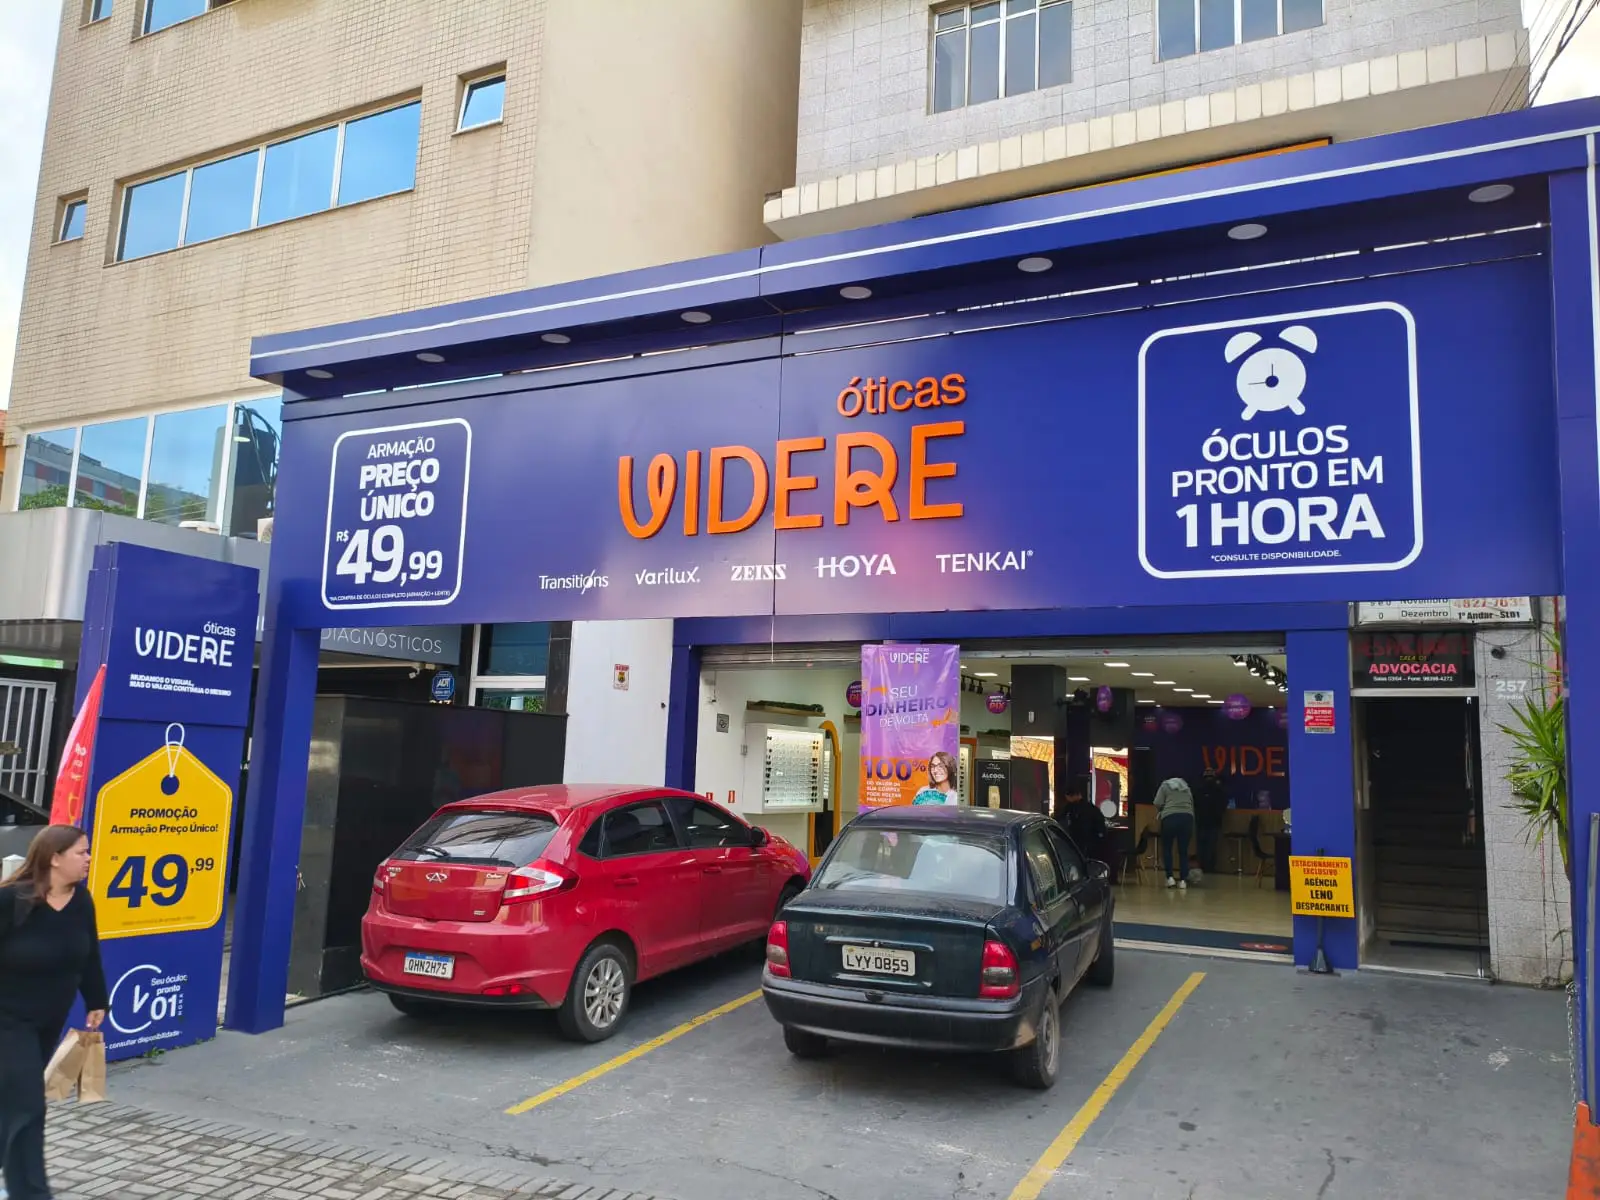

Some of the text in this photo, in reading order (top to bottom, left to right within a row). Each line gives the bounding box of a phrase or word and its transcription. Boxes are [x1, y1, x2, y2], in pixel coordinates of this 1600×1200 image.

[837, 373, 966, 417] óticas
[367, 436, 435, 458] ARMAÇÃO
[1202, 425, 1349, 463] ÓCULOS
[359, 458, 440, 491] PREÇO
[618, 420, 966, 539] VIDERE
[1172, 455, 1384, 497] PRONTO EM
[360, 489, 435, 521] ÚNICO
[1176, 493, 1386, 547] 1 HORA
[336, 530, 349, 542] R$
[1261, 550, 1342, 561] DISPONIBILIDADE.
[539, 569, 609, 595] Transitions
[731, 564, 787, 582] ZEISS
[815, 553, 896, 578] HOYA
[1401, 609, 1449, 617] Dezembro
[1467, 611, 1493, 619] Andar
[203, 621, 236, 636] óticas
[135, 627, 235, 667] VIDERE
[889, 652, 929, 664] VIDERE
[1369, 663, 1457, 674] ADVOCACIA
[130, 673, 164, 684] MUDAMOS
[891, 685, 918, 699] SEU
[1495, 680, 1526, 692] 257
[866, 697, 948, 716] DINHEIRO
[880, 713, 929, 728] DE VOLTA
[129, 806, 198, 820] PROMOÇÃO
[110, 821, 218, 836] Armação Preço Único!
[1291, 860, 1349, 869] ESTACIONAMENTO
[1303, 867, 1338, 876] EXCLUSIVO
[1304, 877, 1338, 888] AGÊNCIA
[1310, 889, 1333, 900] LENO
[1295, 901, 1350, 913] DESPACHANTE
[151, 977, 165, 986] Seu
[156, 984, 181, 996] pronto
[151, 994, 177, 1020] 01
